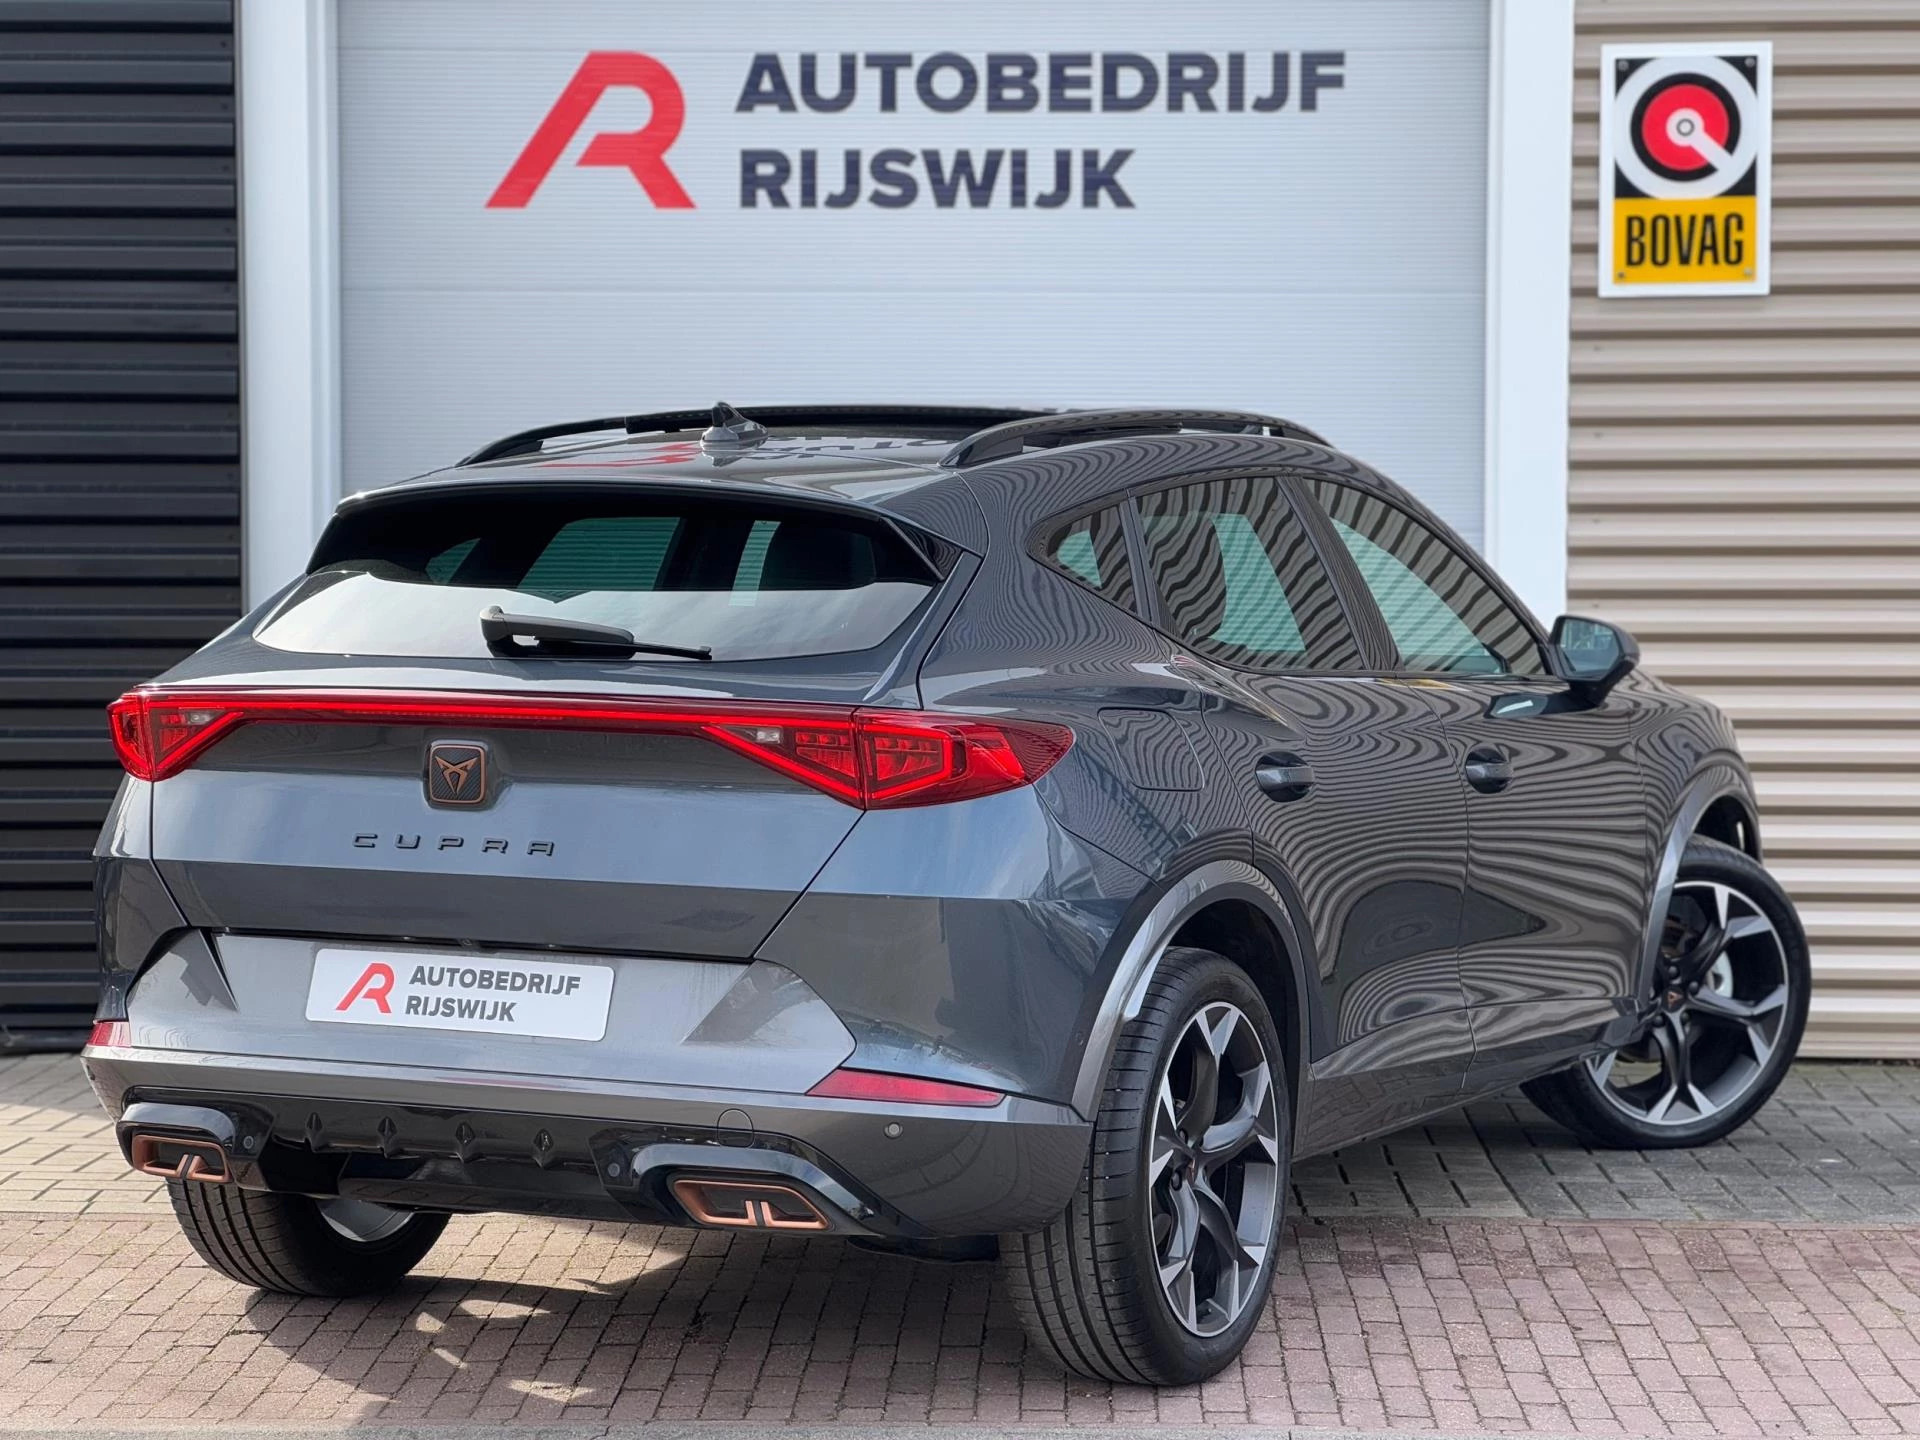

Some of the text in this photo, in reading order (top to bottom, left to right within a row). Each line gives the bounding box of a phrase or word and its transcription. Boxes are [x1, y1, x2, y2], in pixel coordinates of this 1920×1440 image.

[735, 50, 1347, 114] AUTOBEDRIJF
[739, 148, 1136, 210] RIJSWIJK
[1625, 212, 1744, 268] BOVAG
[352, 832, 556, 857] CUPRA
[409, 965, 581, 997] AUTOBEDRIJF
[404, 995, 517, 1023] RIJSWIJK
